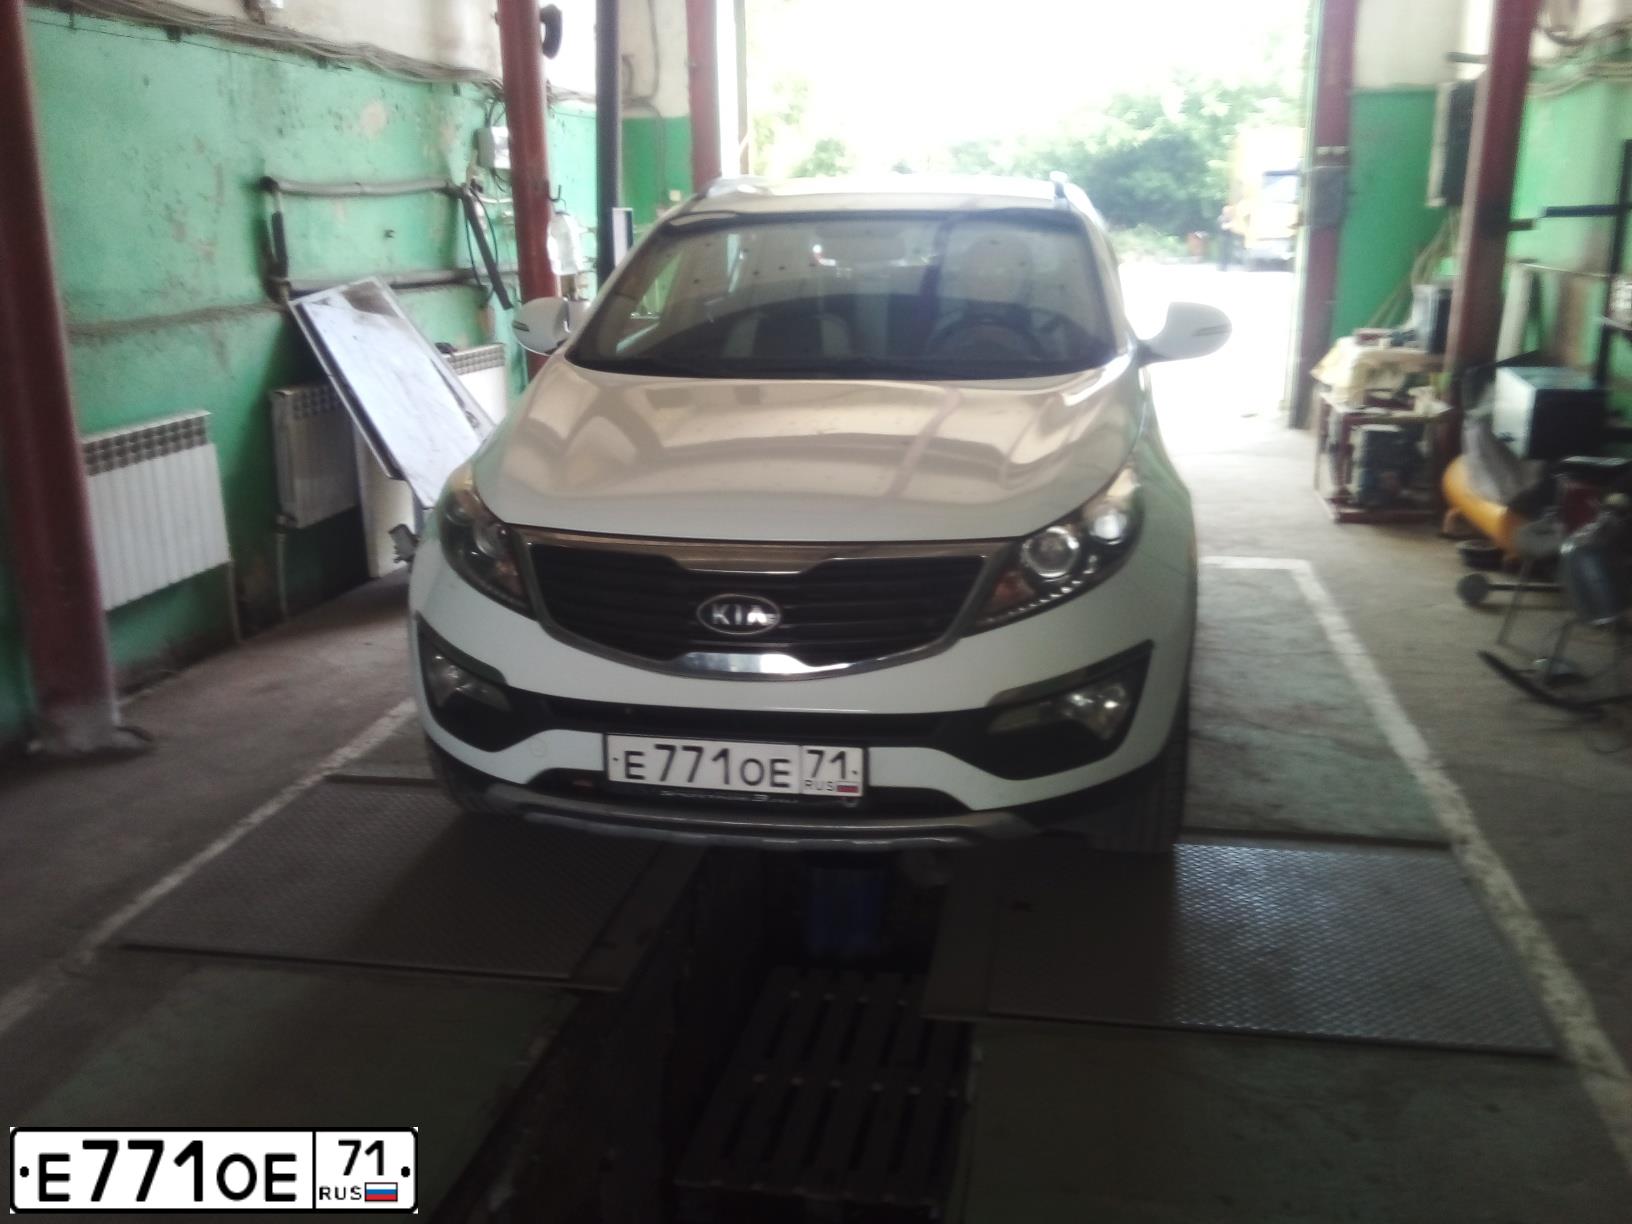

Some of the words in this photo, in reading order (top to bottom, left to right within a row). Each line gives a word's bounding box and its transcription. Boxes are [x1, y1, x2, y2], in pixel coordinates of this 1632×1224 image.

[711, 603, 777, 626] KIA
[624, 743, 792, 789] E771OE
[807, 749, 847, 780] 71
[804, 779, 835, 792] RUS
